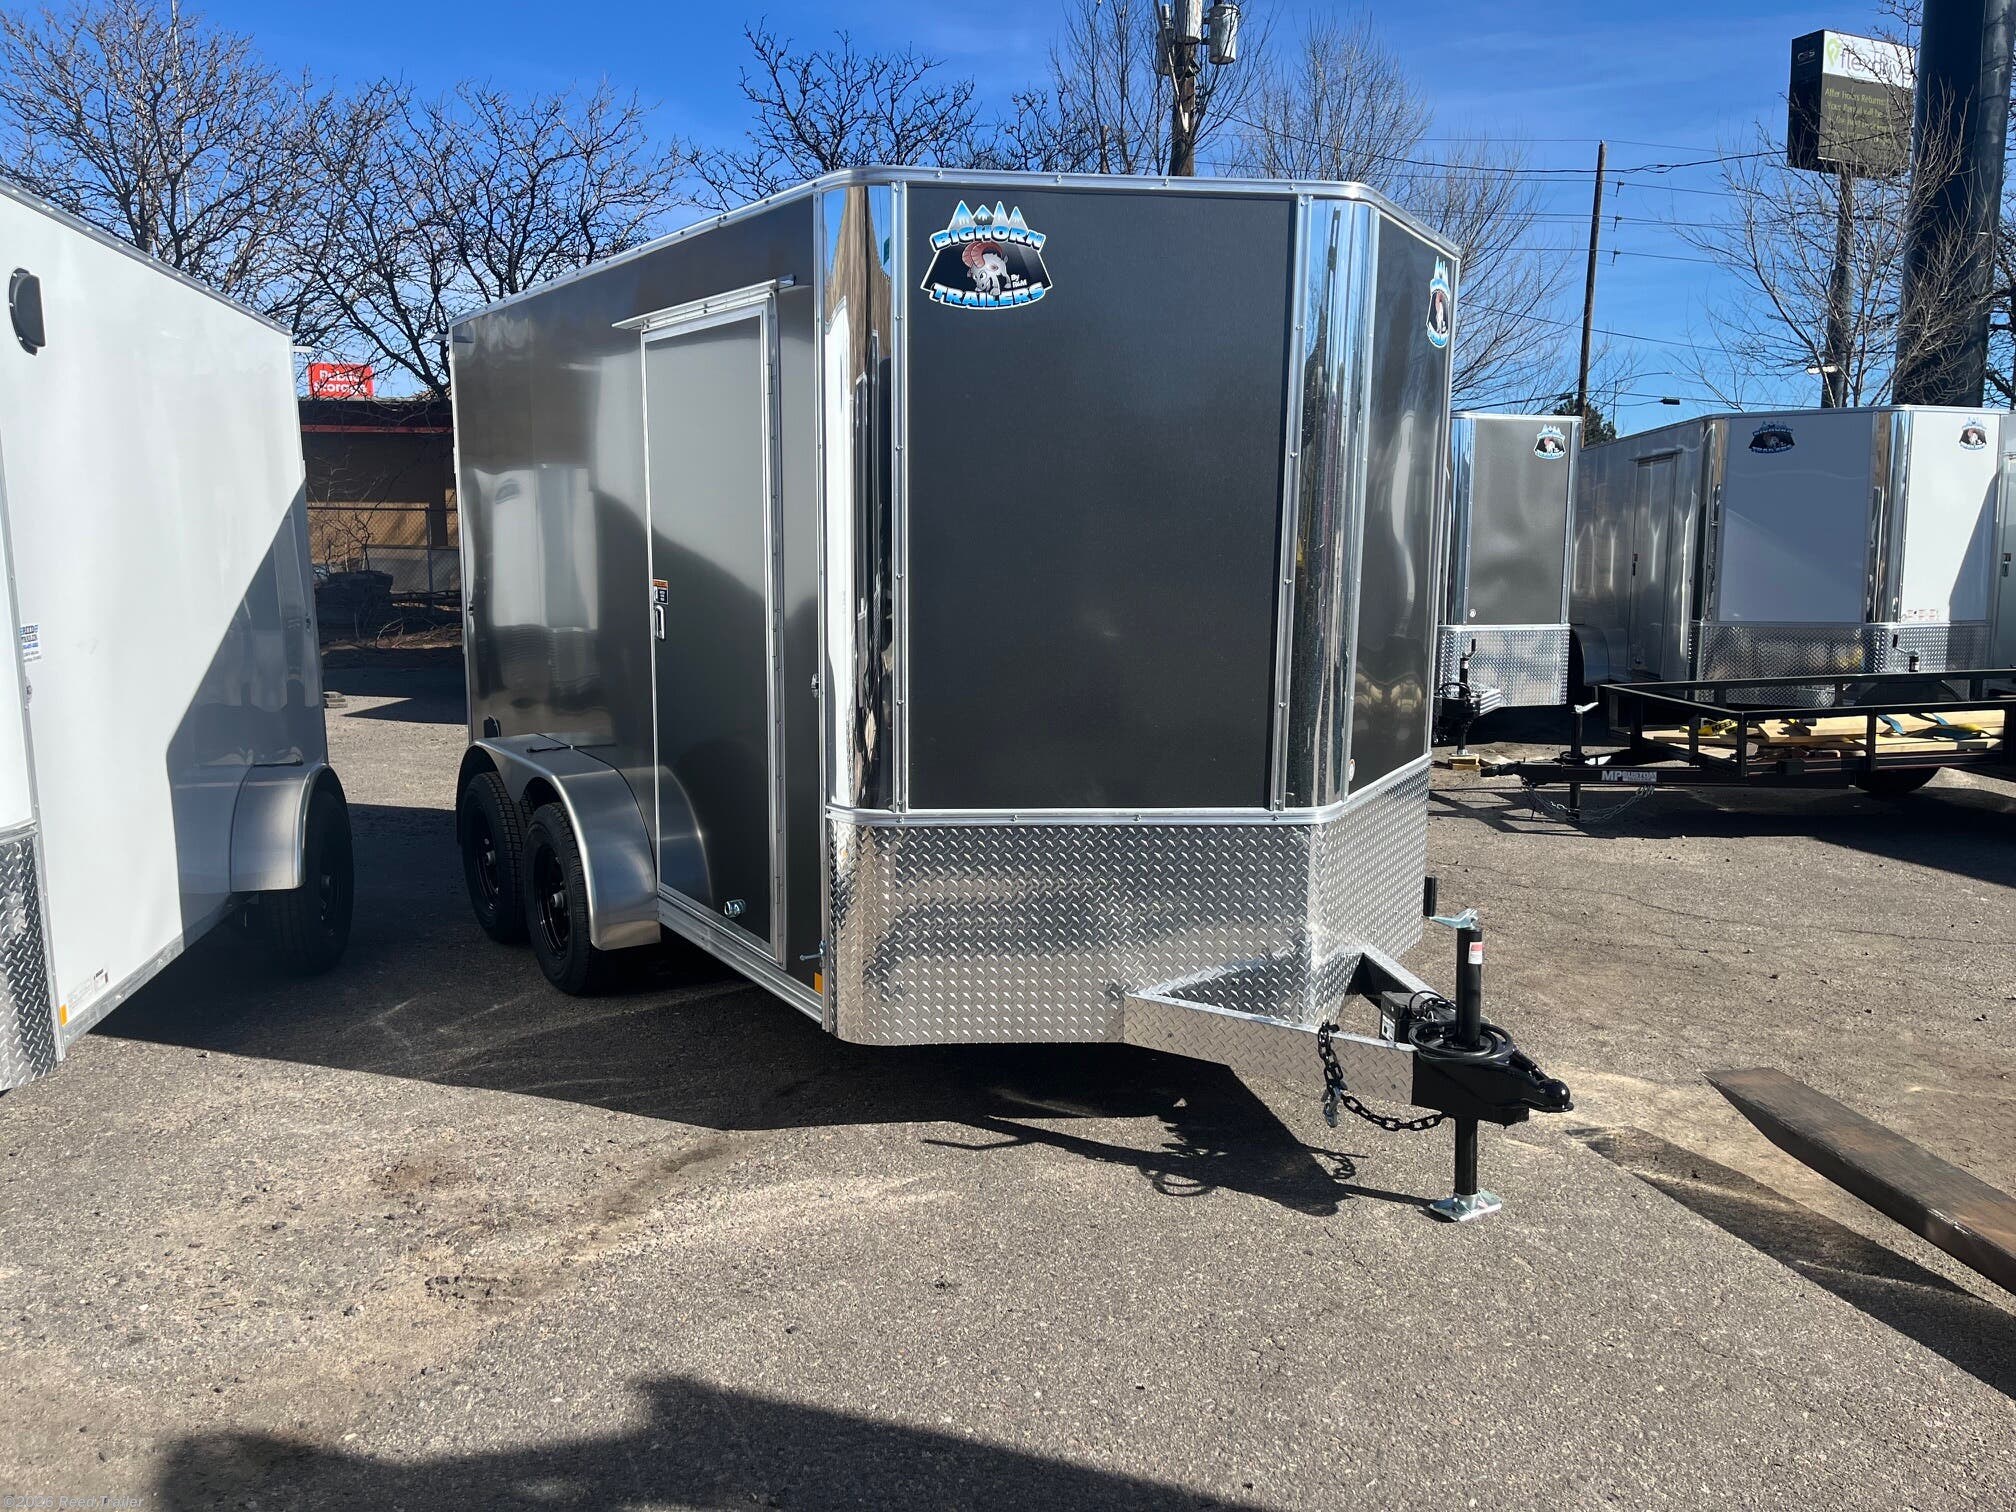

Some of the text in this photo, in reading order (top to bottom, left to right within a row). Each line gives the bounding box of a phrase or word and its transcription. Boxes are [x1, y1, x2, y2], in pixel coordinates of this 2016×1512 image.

[932, 225, 1044, 249] BIGHORN
[932, 282, 1045, 307] TRAILERS
[1601, 770, 1622, 781] MP
